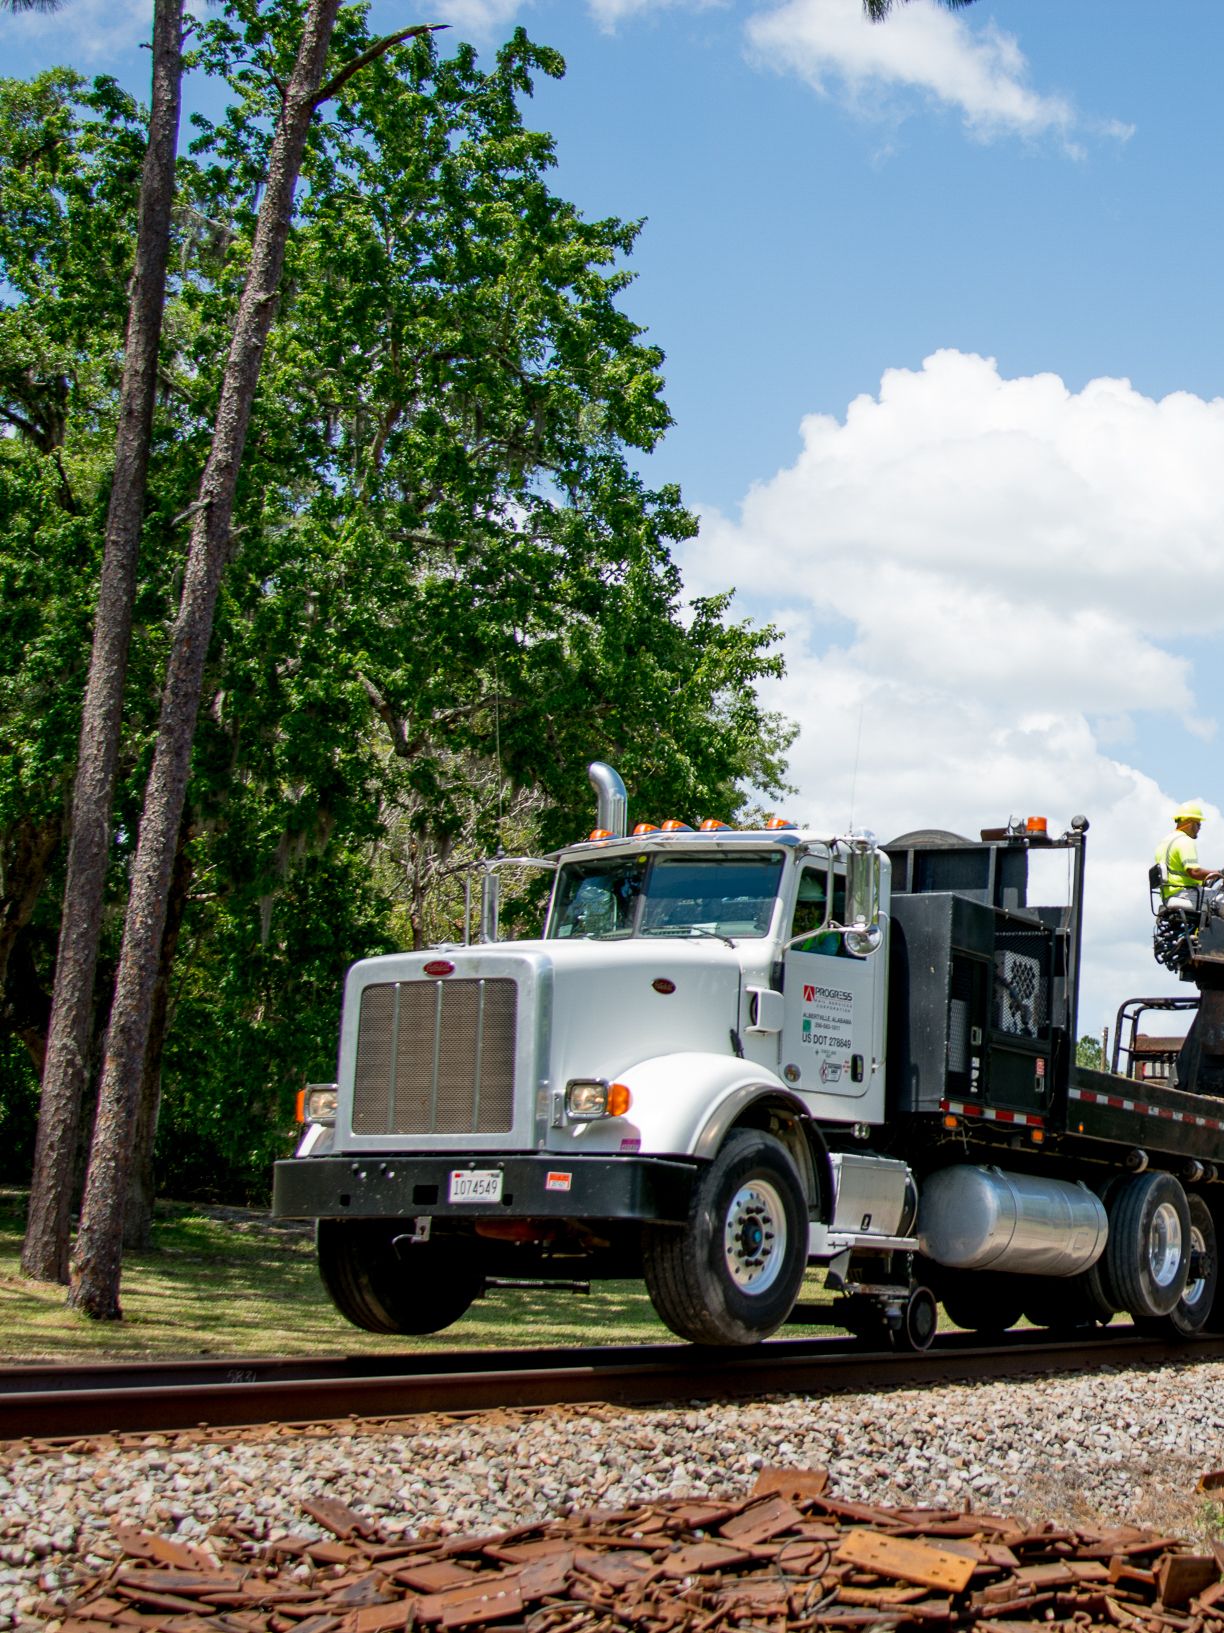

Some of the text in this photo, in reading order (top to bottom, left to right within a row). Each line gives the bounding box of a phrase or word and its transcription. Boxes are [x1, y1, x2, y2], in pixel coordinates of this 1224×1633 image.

[815, 986, 852, 1002] PROGRESS
[815, 1003, 851, 1013] CORPORATION
[832, 1016, 852, 1025] ALABAMA
[802, 1032, 812, 1043] US
[813, 1034, 828, 1046] DOT
[454, 1179, 498, 1195] 1074549
